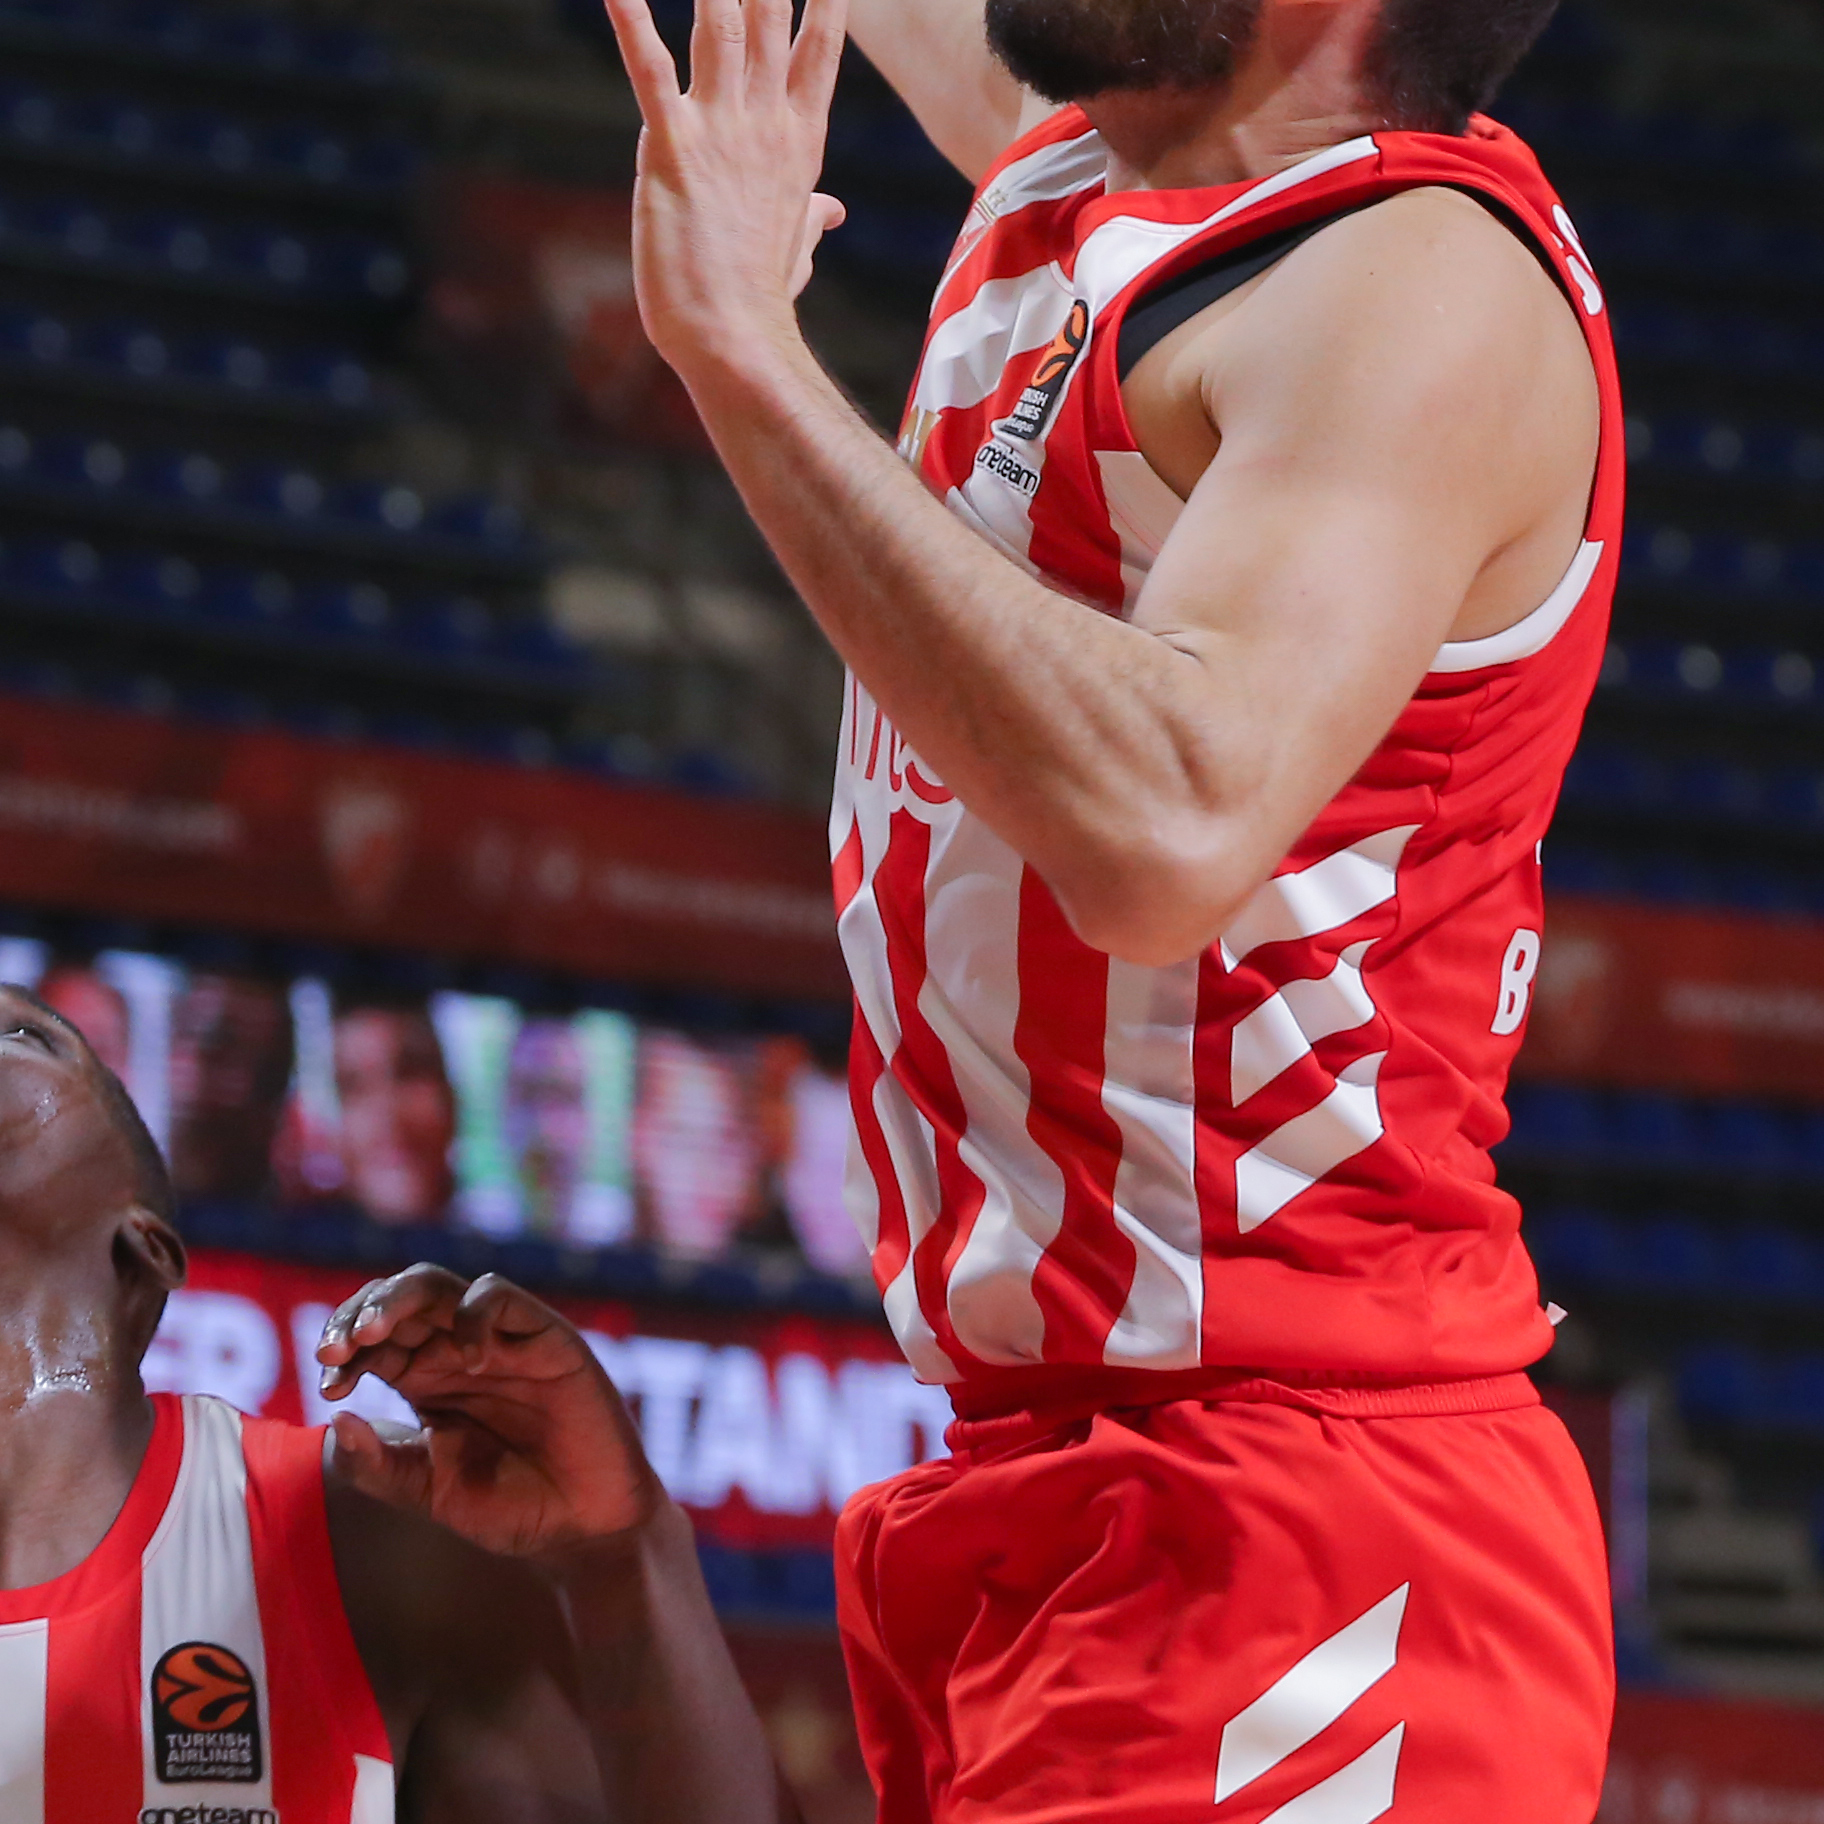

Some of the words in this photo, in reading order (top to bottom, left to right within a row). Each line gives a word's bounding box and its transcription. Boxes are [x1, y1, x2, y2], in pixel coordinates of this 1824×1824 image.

[579, 1329, 957, 1516] TAND
[166, 1733, 252, 1748] TURKISH
[166, 1748, 253, 1764] AIRLINES
